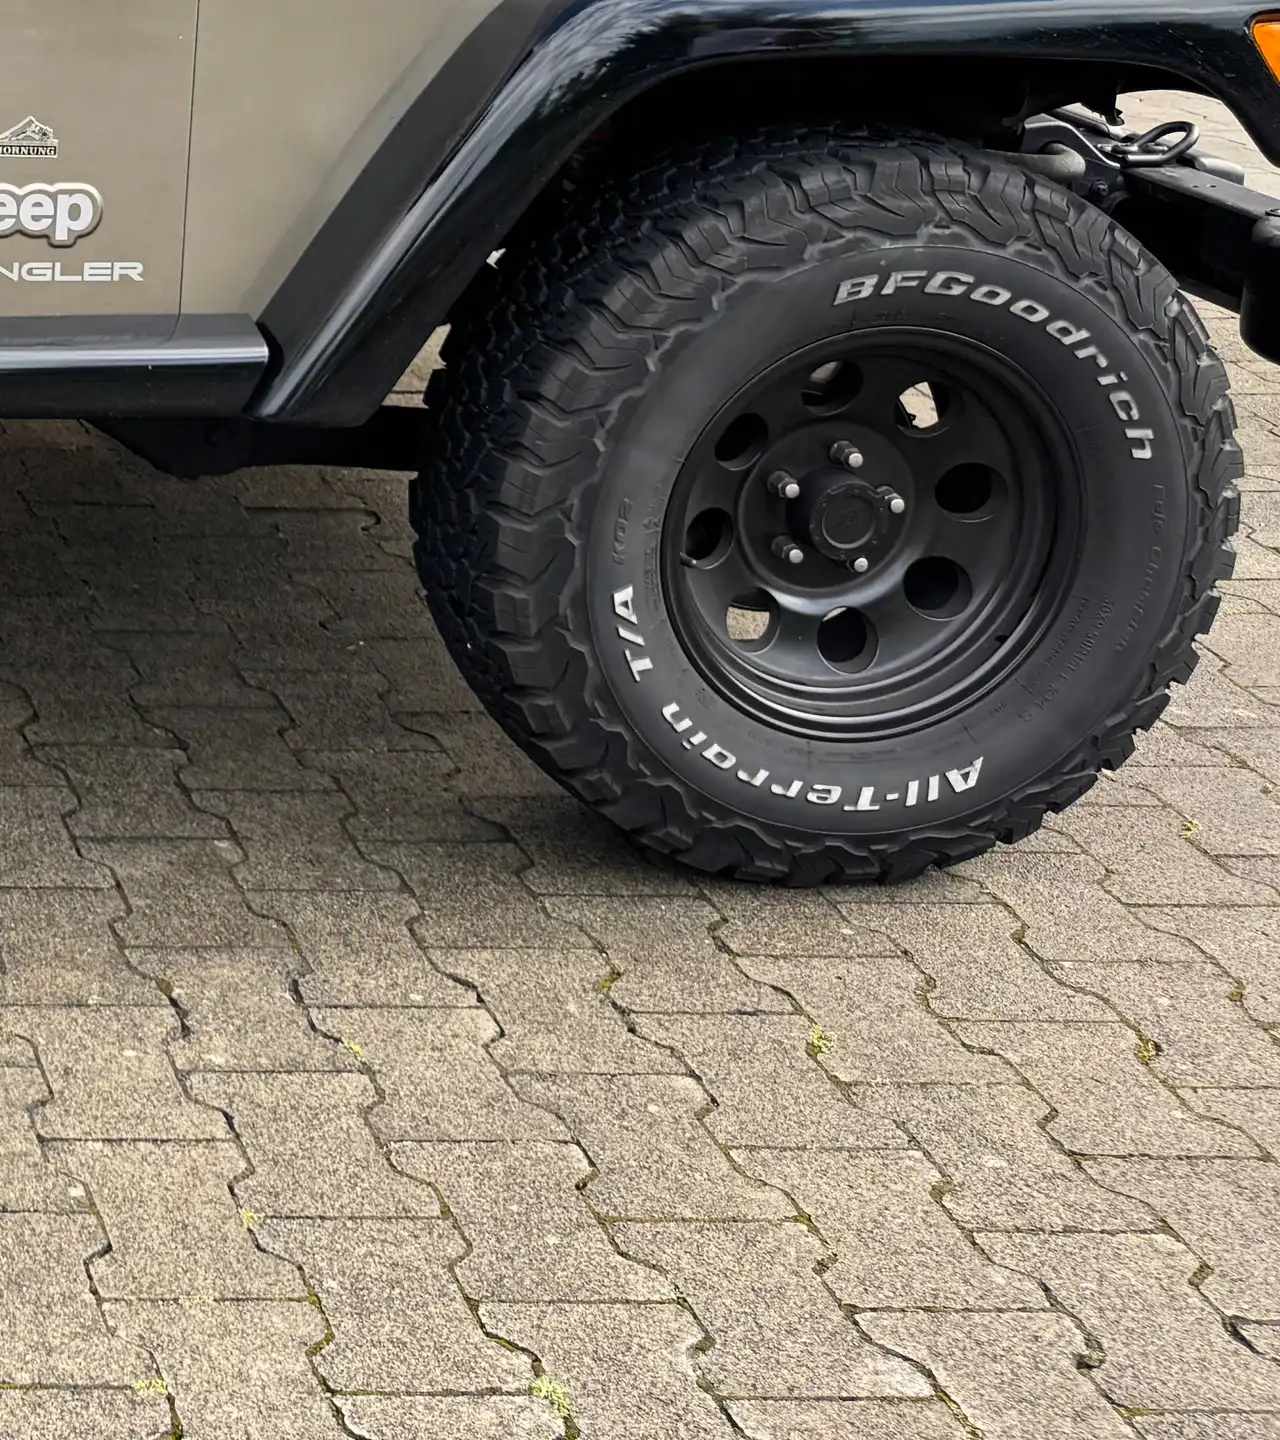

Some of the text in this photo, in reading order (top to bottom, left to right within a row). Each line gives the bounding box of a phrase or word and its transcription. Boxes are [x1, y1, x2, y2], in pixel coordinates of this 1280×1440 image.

[833, 270, 1155, 462] BFGoodrich
[609, 583, 656, 684] T/A
[662, 700, 985, 813] All-Terrain
